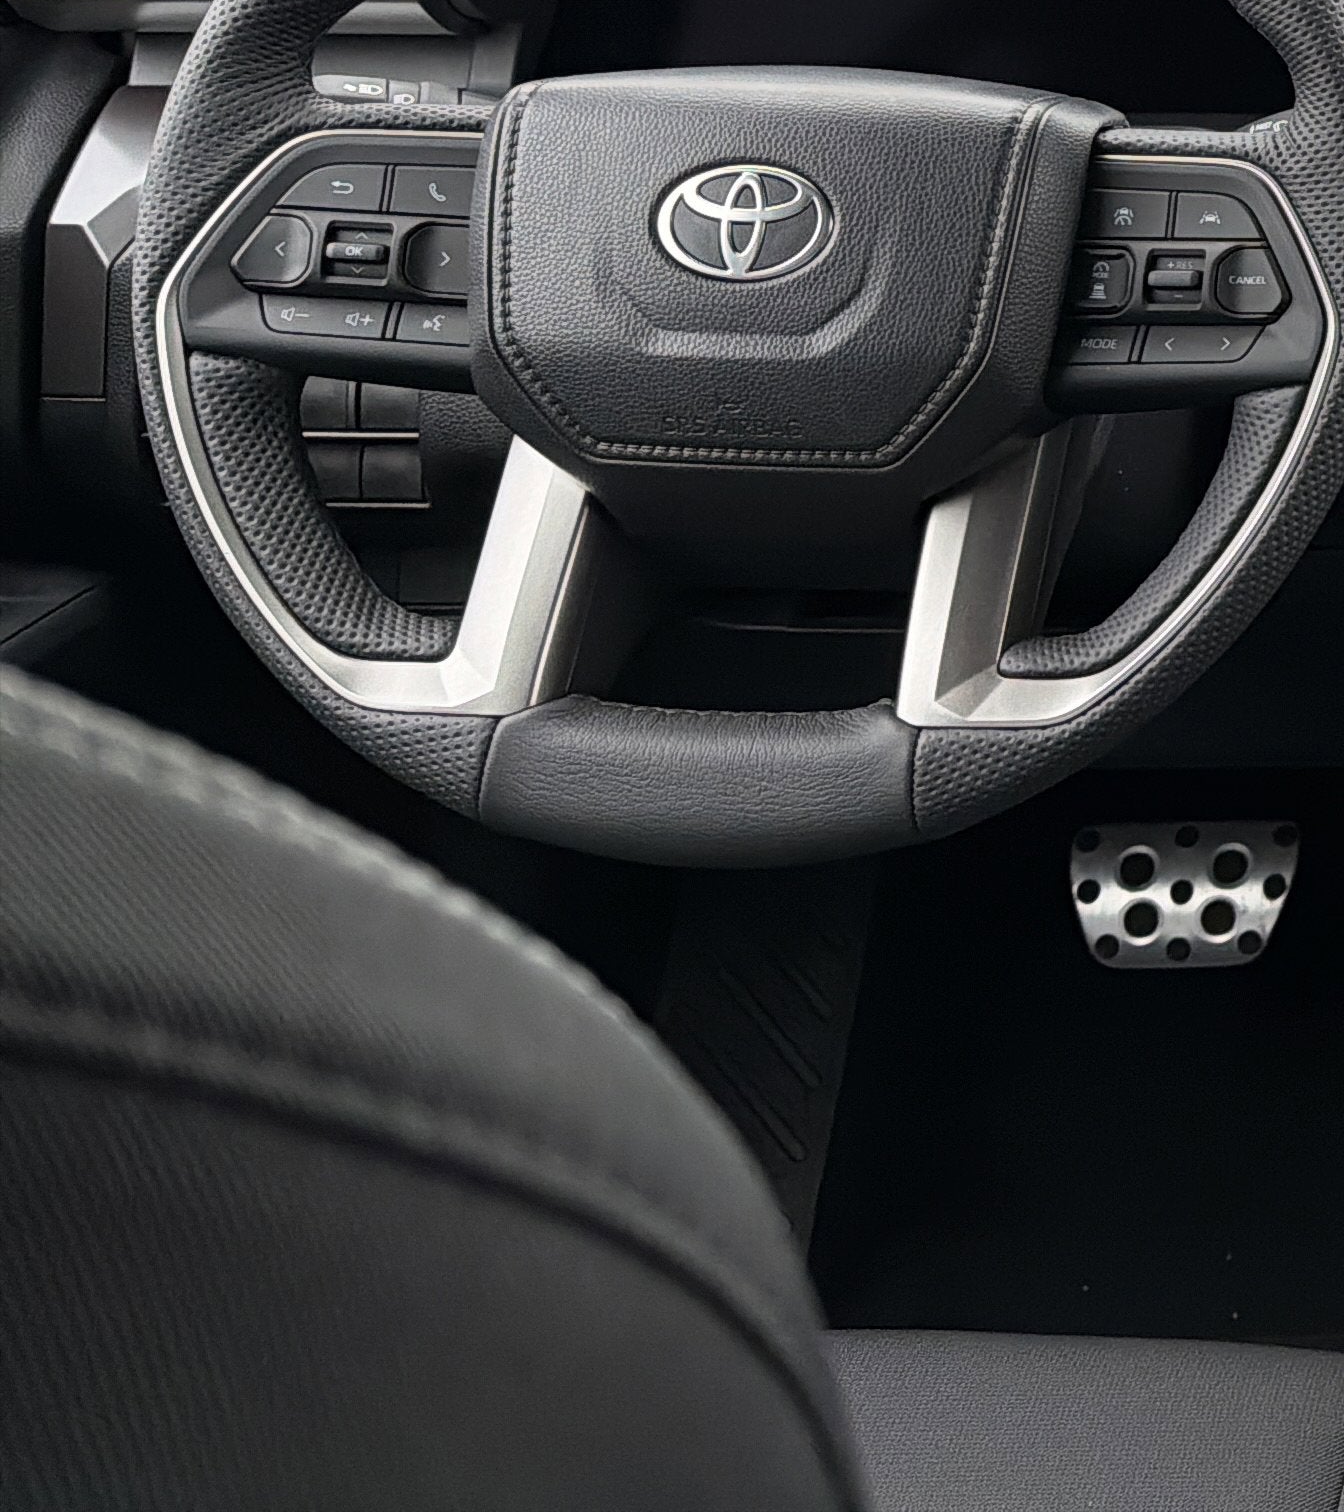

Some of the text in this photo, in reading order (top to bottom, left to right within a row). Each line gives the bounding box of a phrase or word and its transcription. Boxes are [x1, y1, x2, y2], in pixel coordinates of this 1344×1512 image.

[345, 245, 364, 257] OK
[1228, 275, 1267, 285] CANCEL
[1080, 338, 1118, 350] MODE
